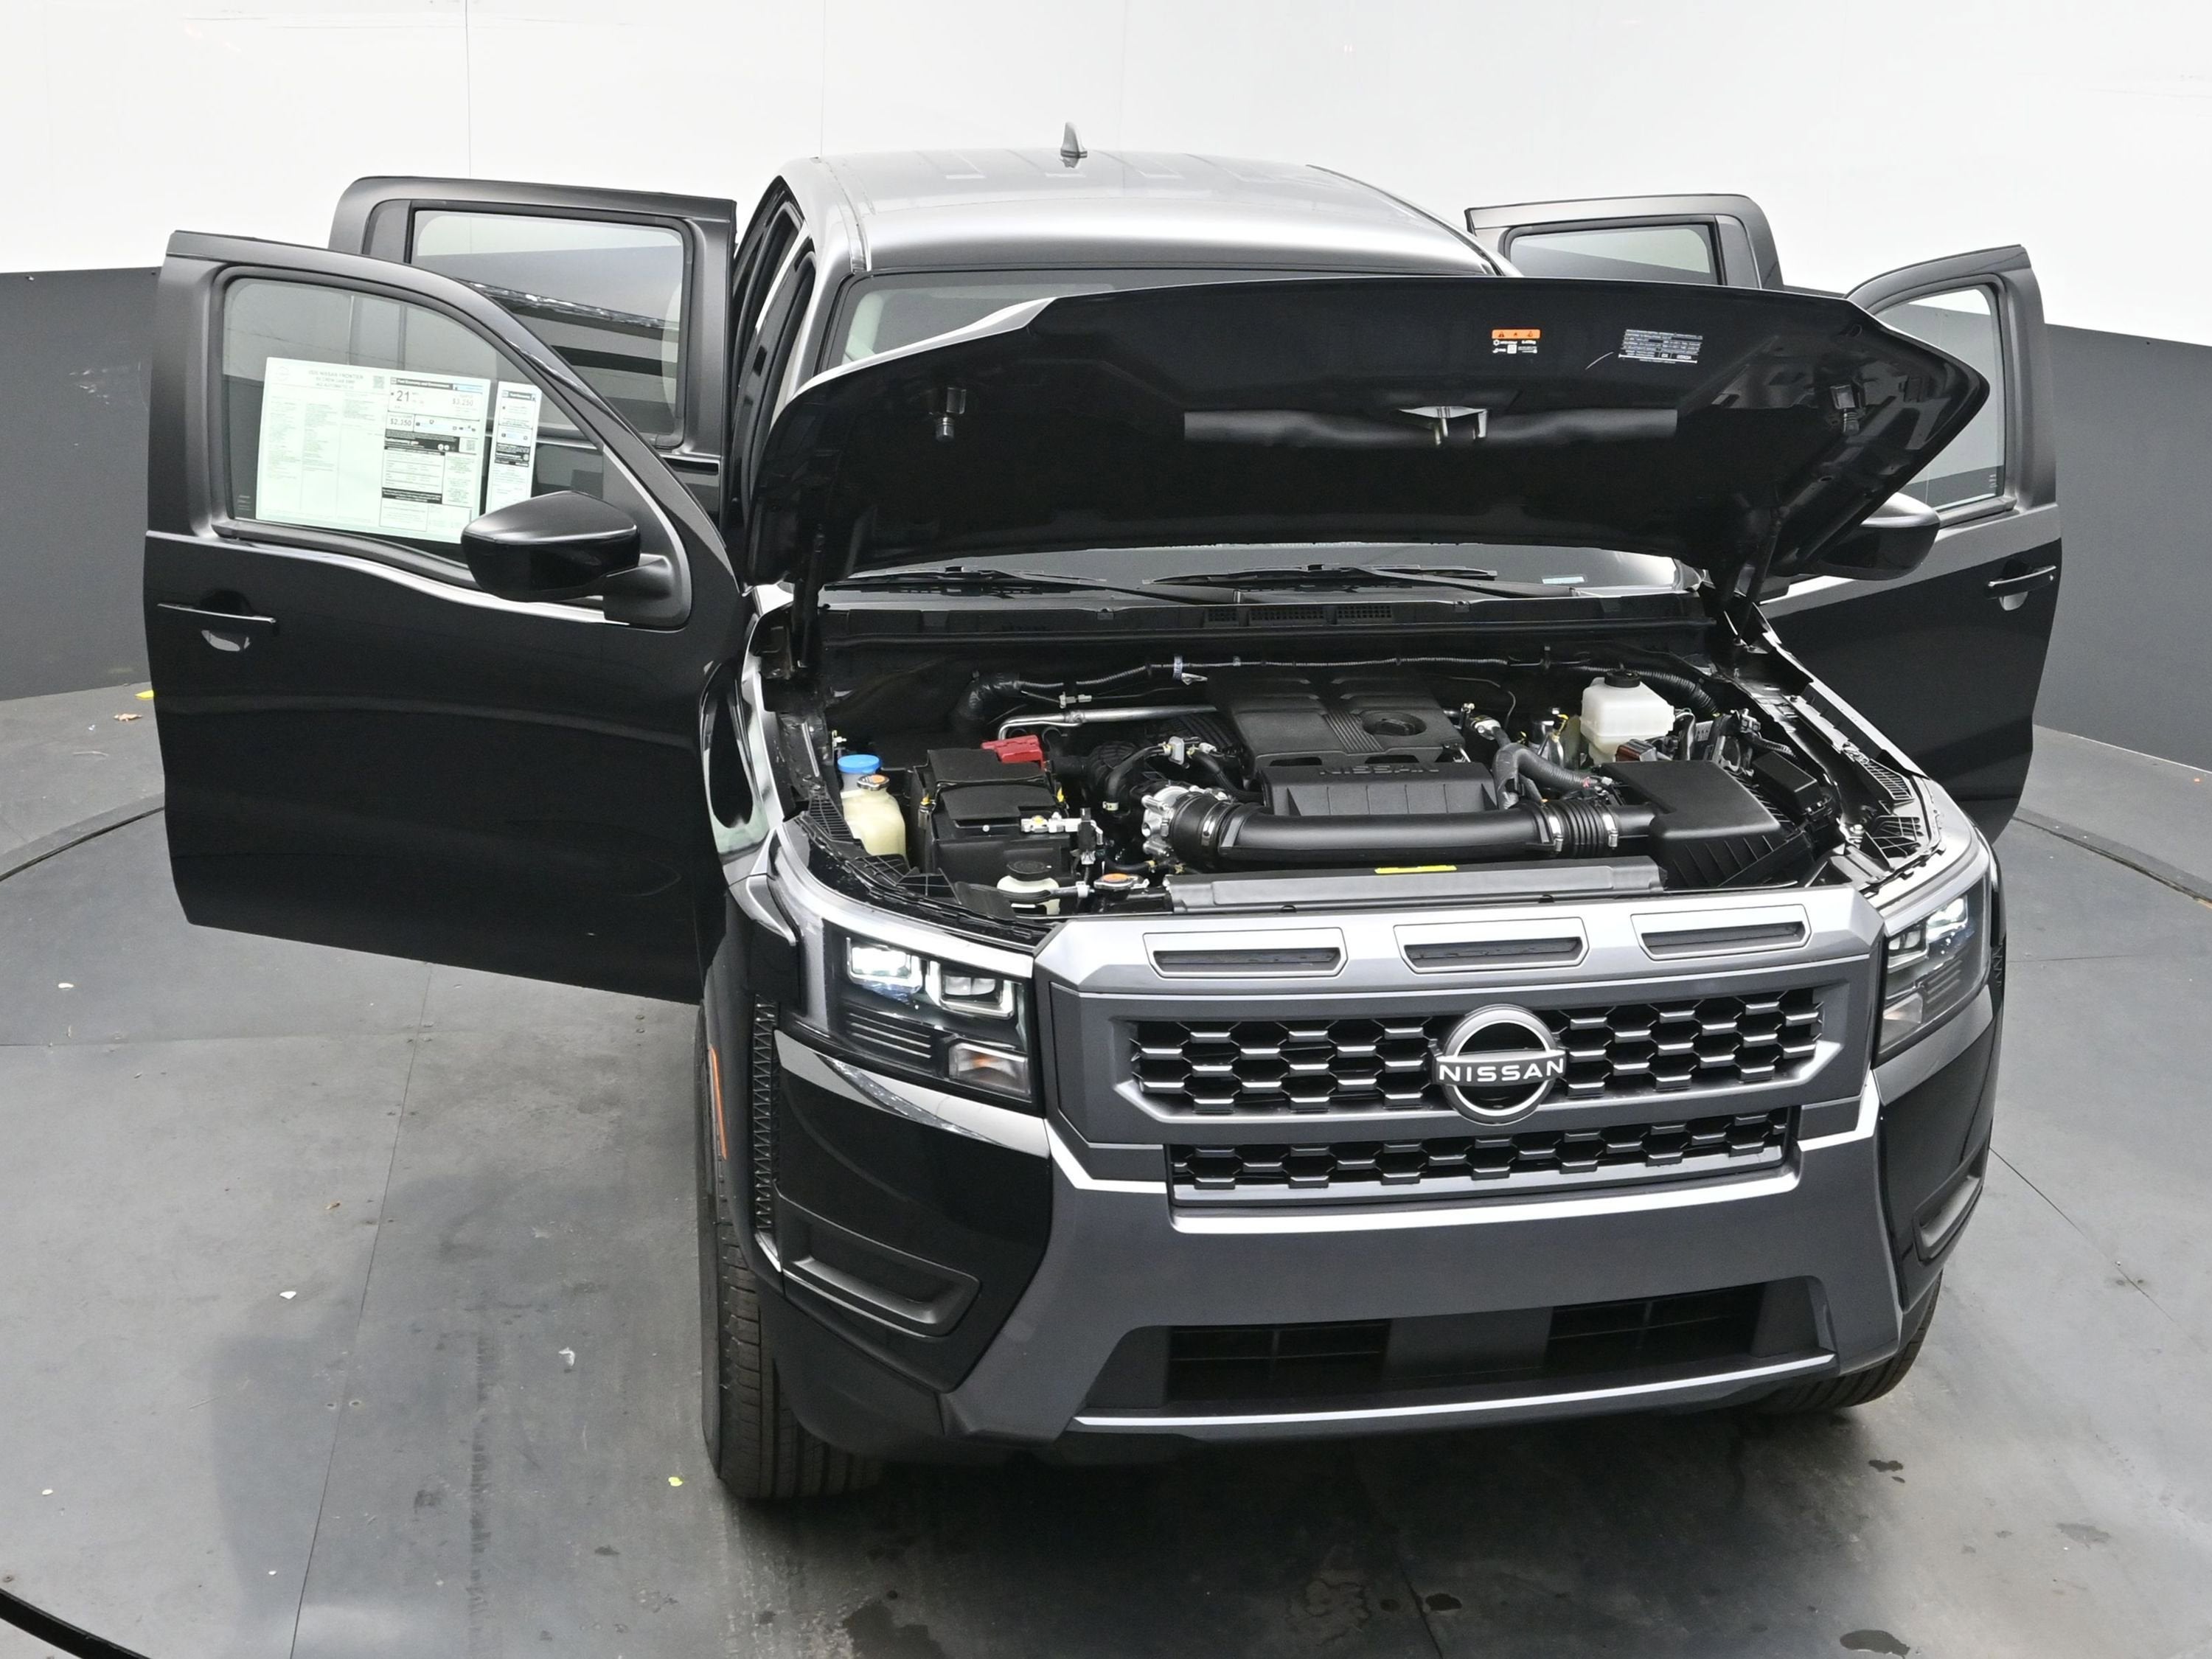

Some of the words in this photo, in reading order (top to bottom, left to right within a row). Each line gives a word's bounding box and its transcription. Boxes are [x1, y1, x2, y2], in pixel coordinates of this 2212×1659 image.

[396, 390, 410, 402] 21
[1319, 764, 1439, 775] NISSAN
[1438, 1057, 1565, 1082] NISSAN
